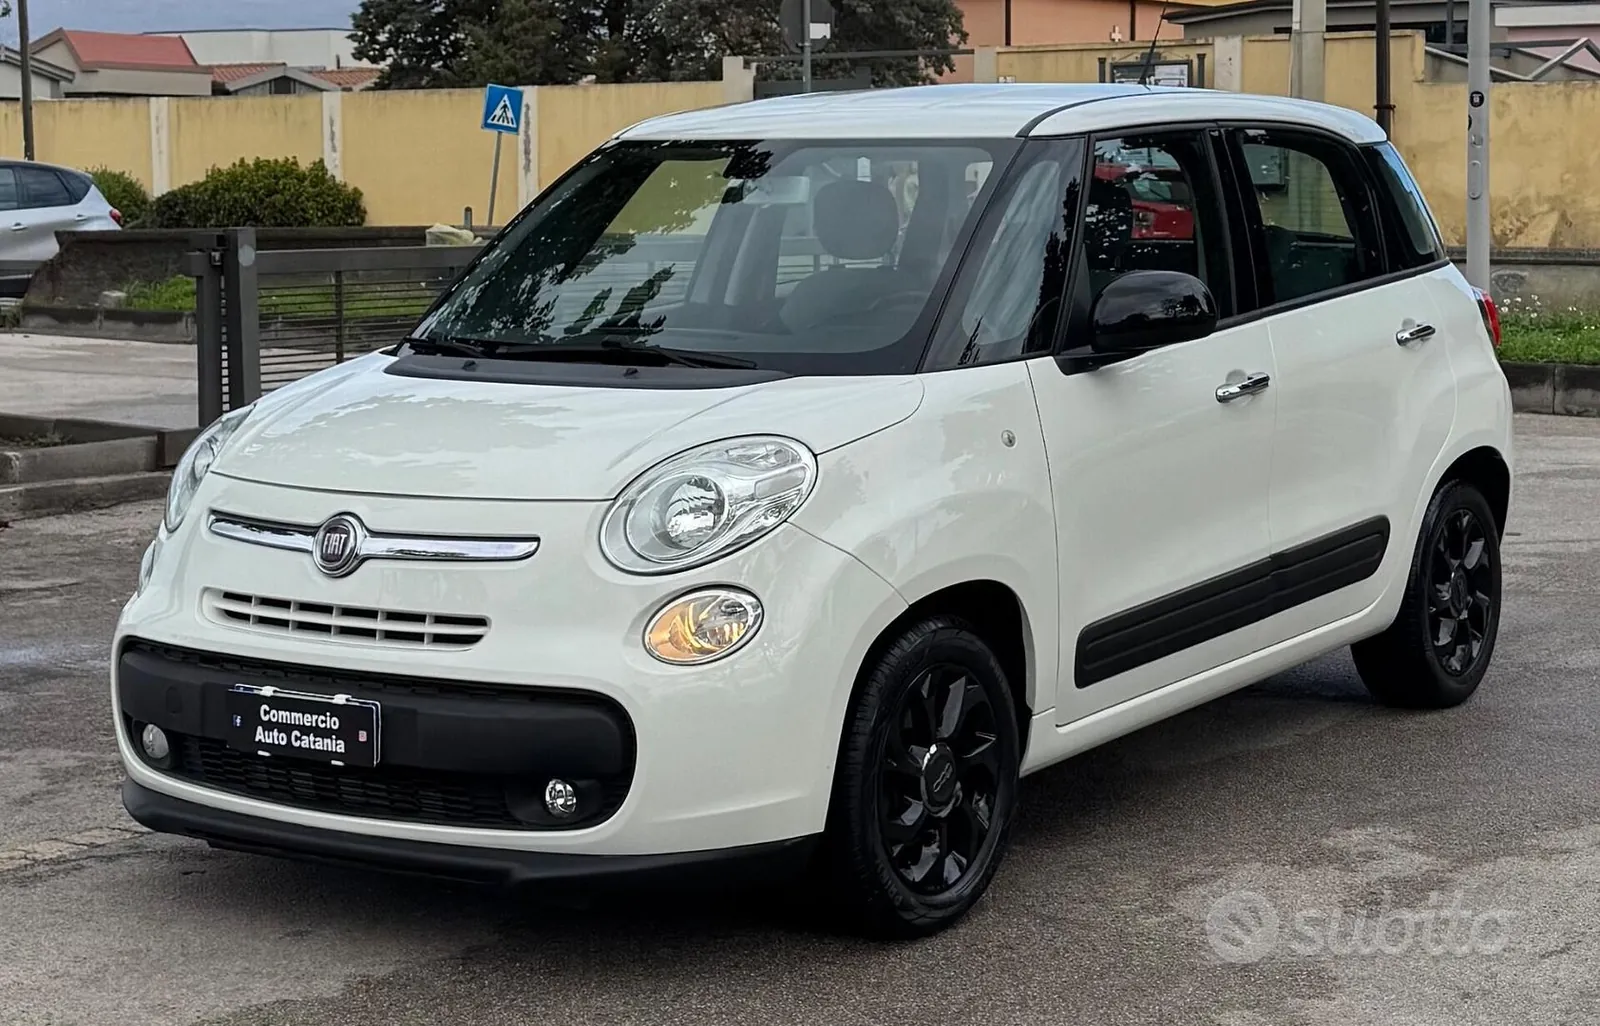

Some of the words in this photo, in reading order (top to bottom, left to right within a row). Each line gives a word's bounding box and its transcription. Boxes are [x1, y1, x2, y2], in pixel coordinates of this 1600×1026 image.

[322, 533, 348, 555] FIAT
[259, 704, 340, 730] Commercio
[254, 725, 288, 746] Auto
[290, 730, 346, 754] Catania
